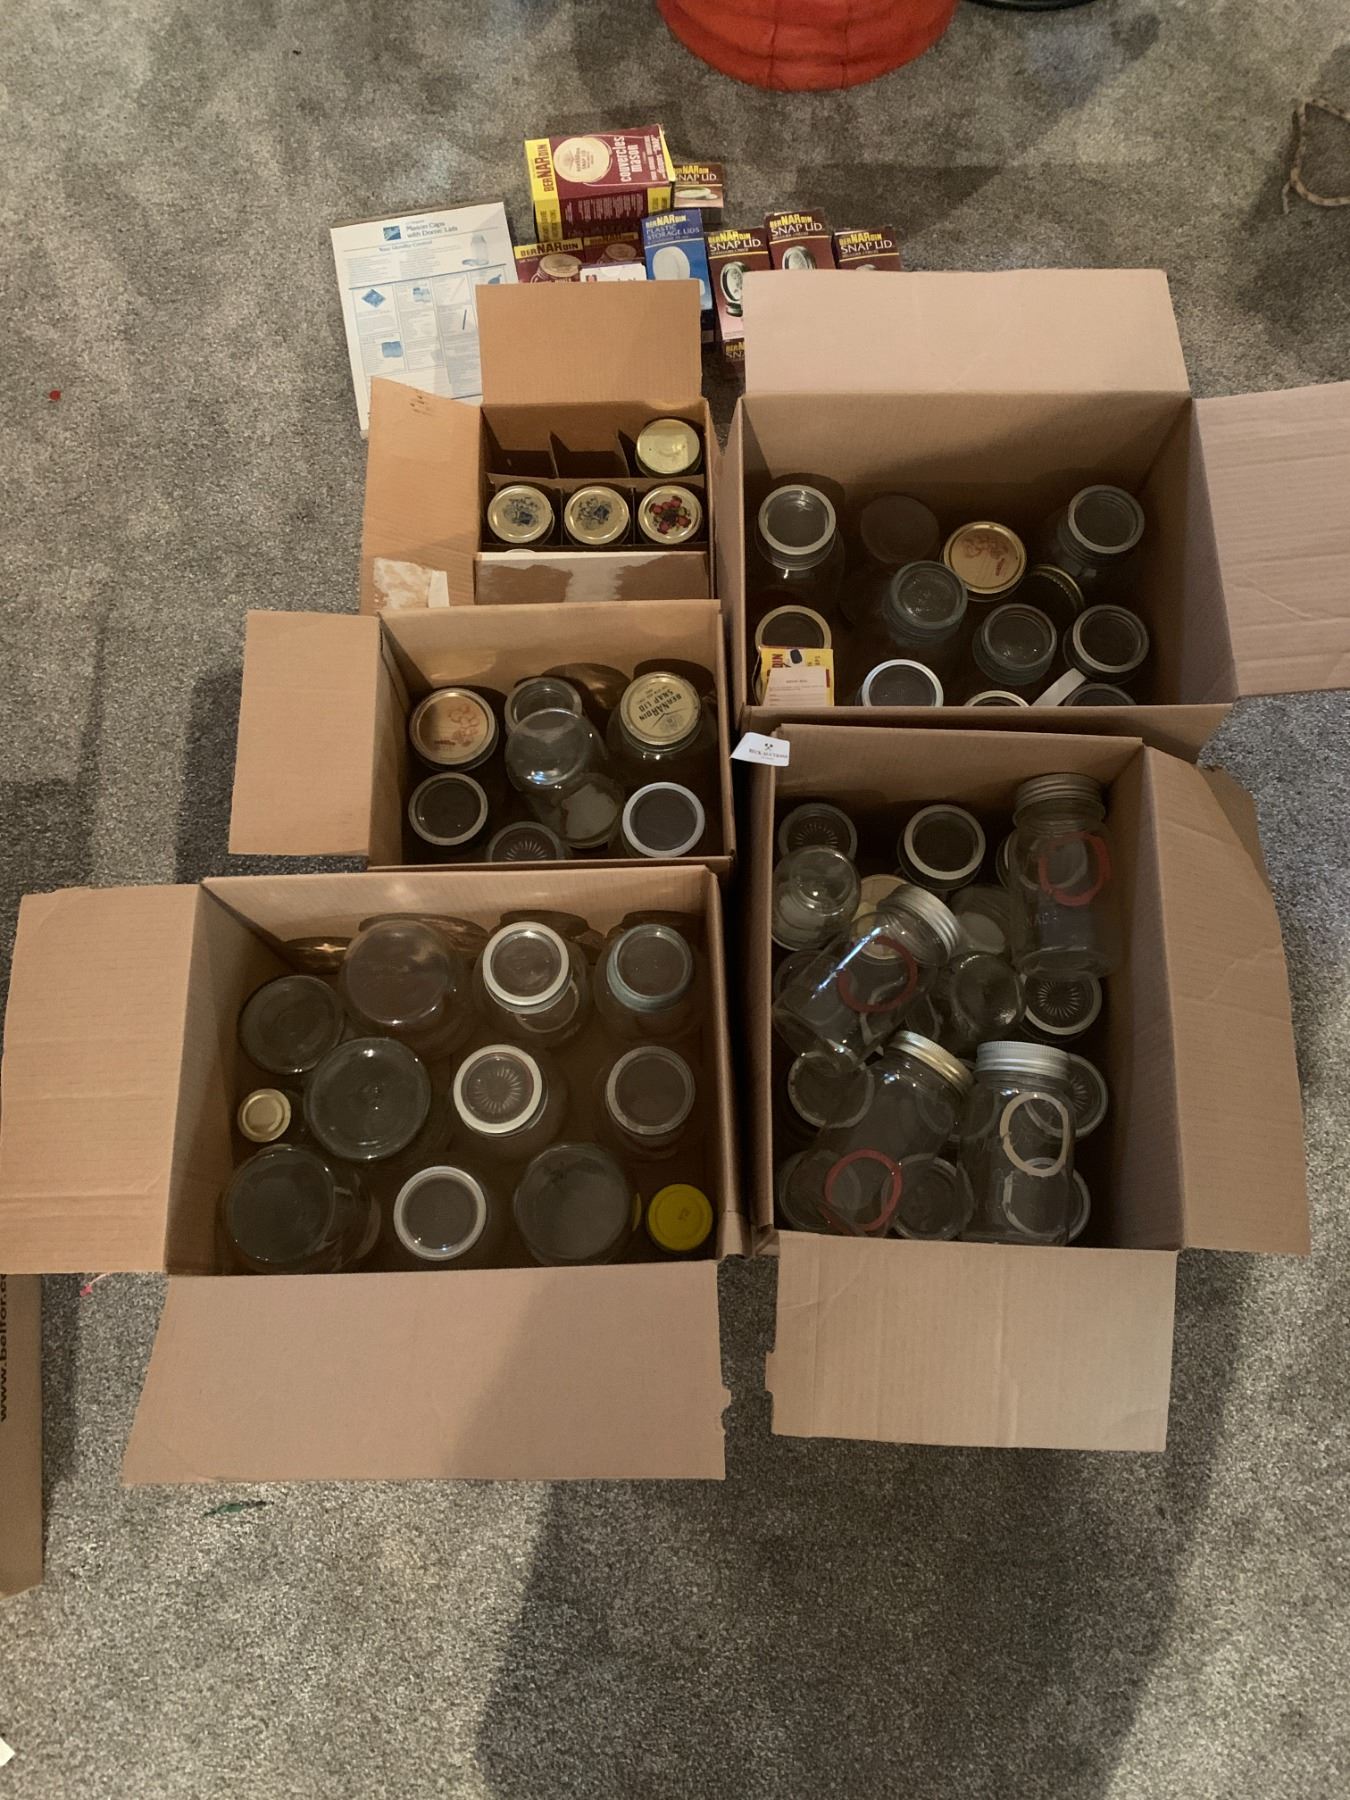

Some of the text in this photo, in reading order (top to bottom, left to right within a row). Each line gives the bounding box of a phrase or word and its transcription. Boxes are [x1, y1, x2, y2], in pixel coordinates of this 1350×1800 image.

[612, 135, 632, 183] couvercles
[627, 144, 643, 173] mason
[535, 144, 554, 192] BERNARDIN
[701, 173, 717, 182] LID
[645, 214, 687, 229] BERNARDIN
[769, 213, 813, 229] BERNARDIN
[646, 224, 677, 235] PLASTIC
[647, 229, 682, 240] STORAGE
[683, 226, 700, 234] LIDS
[771, 224, 803, 237] SNAP
[805, 221, 823, 232] LID
[708, 230, 751, 244] BERNARDIN
[709, 240, 741, 252] SNAP
[743, 237, 761, 248] LID
[839, 232, 882, 246] BERNARDIN
[520, 241, 579, 257] BERNARDIN
[841, 242, 873, 254] SNAP
[875, 239, 893, 250] LID
[654, 689, 674, 704] SNAP
[638, 702, 652, 712] LID
[639, 693, 682, 720] BERNARDIN
